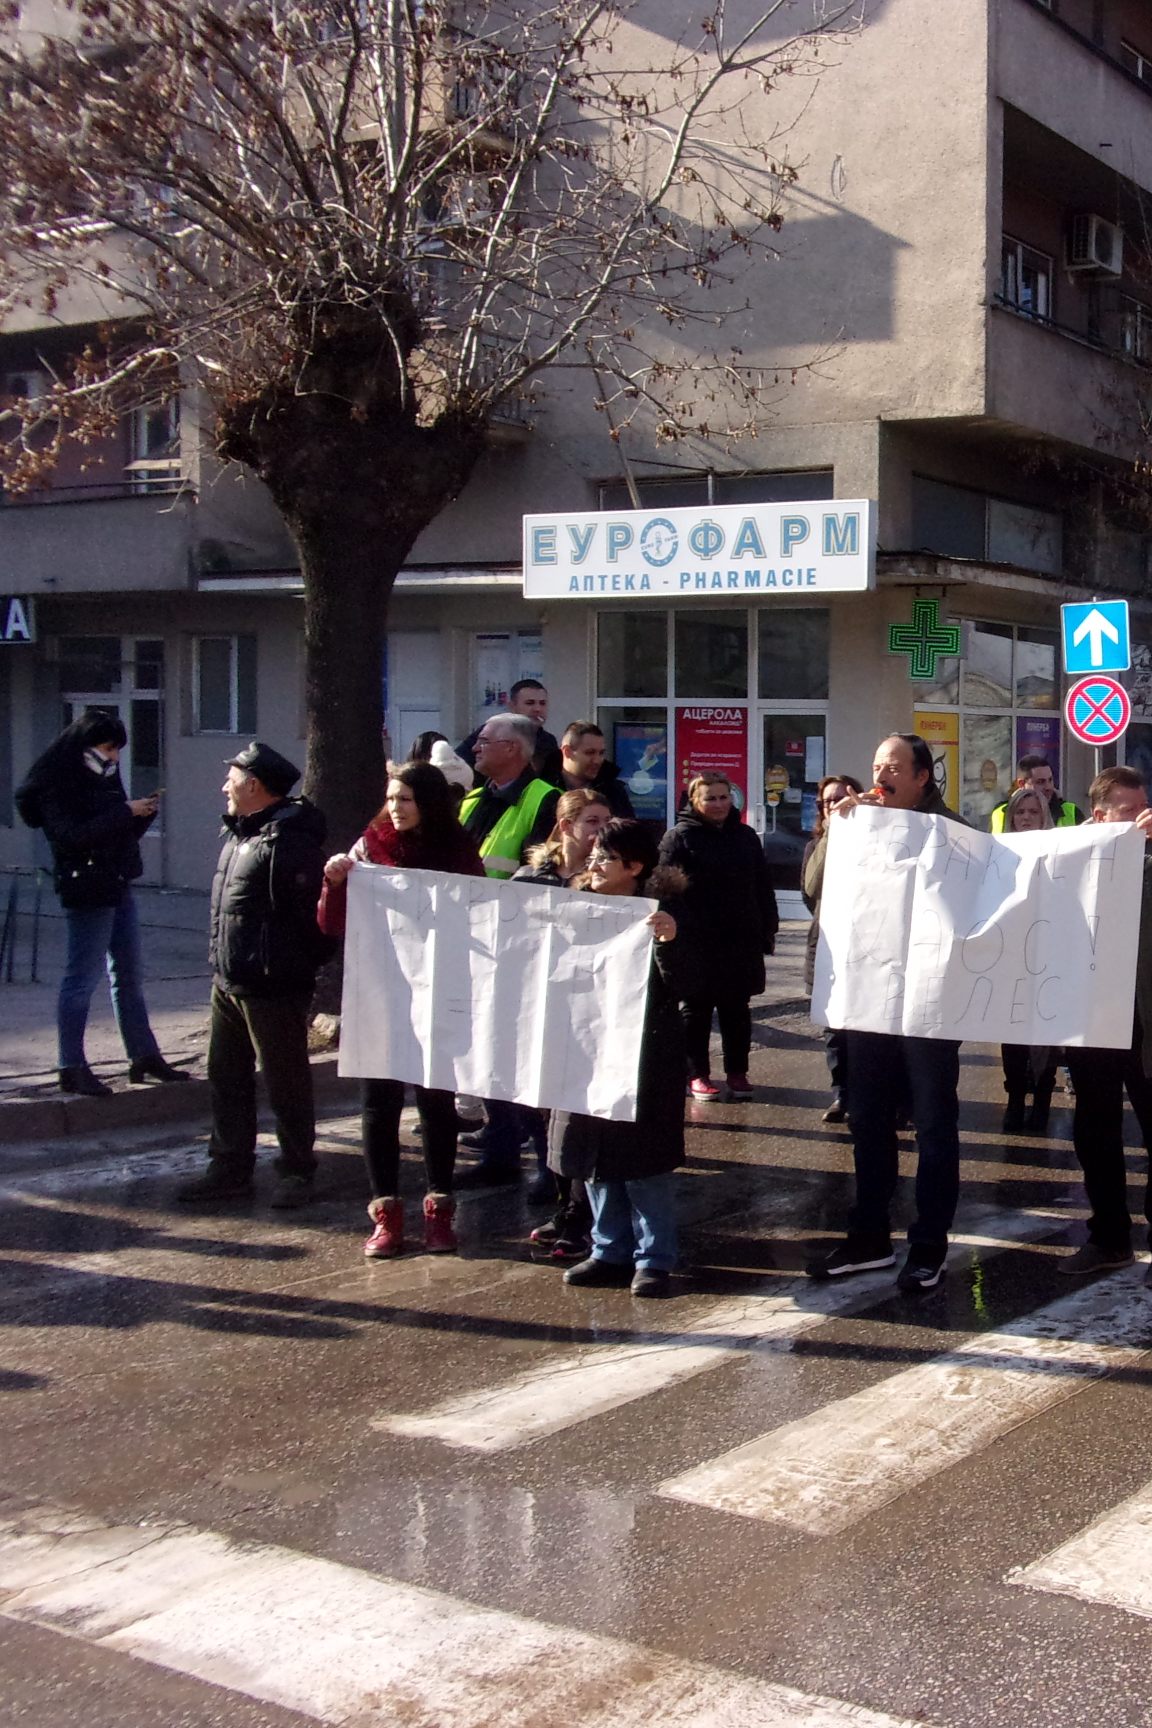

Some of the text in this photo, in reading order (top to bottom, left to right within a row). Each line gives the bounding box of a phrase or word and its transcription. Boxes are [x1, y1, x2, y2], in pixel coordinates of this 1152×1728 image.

[530, 512, 861, 568] ЕУРОФАРМ
[569, 573, 652, 592] АПТЕКА
[680, 567, 818, 589] PHARMACIE
[0, 598, 31, 640] А
[682, 708, 743, 720] АЦЕРОЛА
[882, 972, 1062, 1026] ВЕЛЕС
